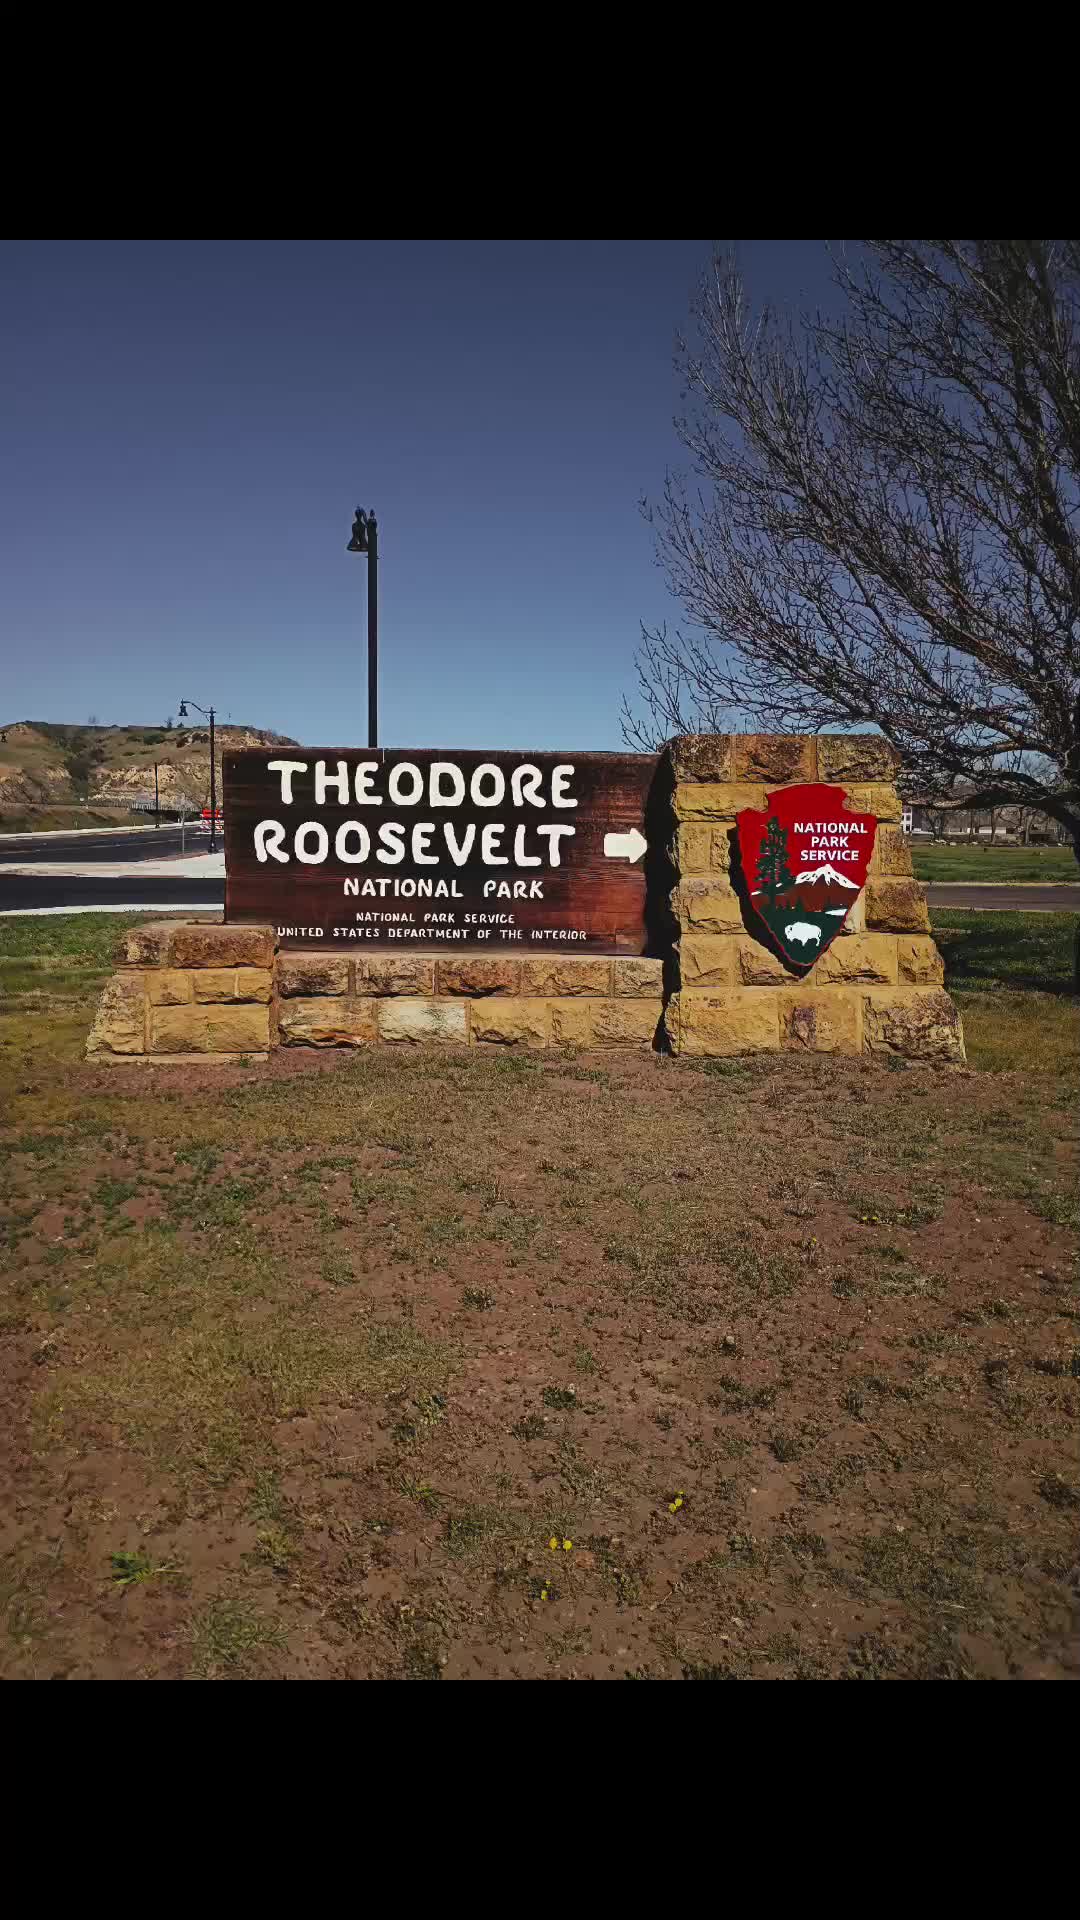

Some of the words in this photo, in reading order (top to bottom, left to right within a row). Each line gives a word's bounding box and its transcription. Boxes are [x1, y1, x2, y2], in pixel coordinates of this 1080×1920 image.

[267, 760, 579, 808] THEODORE
[793, 822, 868, 834] NATIONAL
[253, 820, 576, 868] ROOSEVELT
[811, 836, 849, 847] PARK
[800, 850, 860, 861] SERVICE
[343, 878, 464, 898] NATIONAL
[483, 880, 544, 899] PARK
[356, 912, 416, 922] NATIONAL
[423, 912, 456, 923] PARK
[463, 913, 515, 924] SERVICE
[277, 926, 324, 937] UNITED
[332, 928, 380, 938] STATES
[388, 928, 470, 939] DEPARTMENT
[477, 929, 492, 939] OF
[499, 929, 523, 940] THE
[531, 930, 590, 940] INTERIOR
